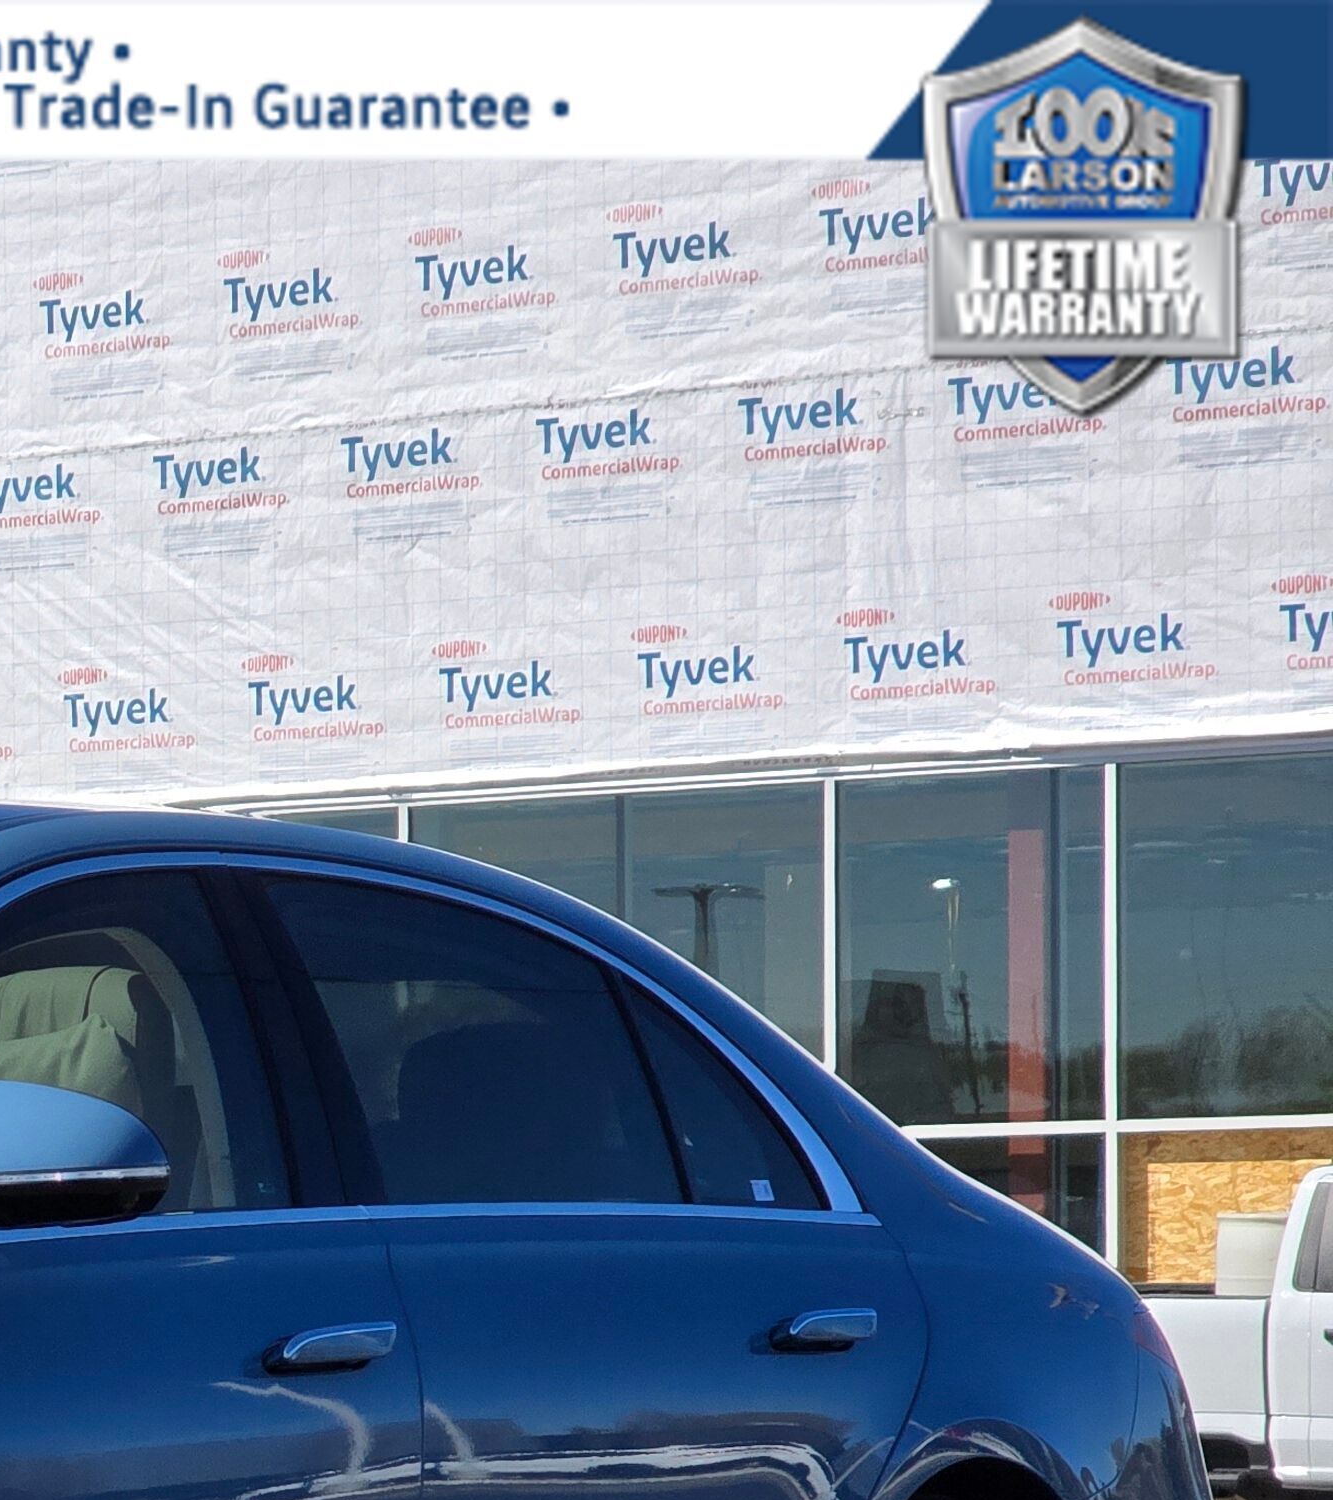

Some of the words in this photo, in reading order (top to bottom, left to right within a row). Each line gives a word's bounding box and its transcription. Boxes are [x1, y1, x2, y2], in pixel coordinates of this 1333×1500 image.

[416, 246, 528, 300] Tyvek
[615, 223, 731, 278] Tyvek
[43, 293, 145, 342] Tyvek
[225, 271, 332, 320] Tyvek
[45, 334, 171, 359] CommercialWrap
[230, 313, 359, 340] CommercialWrap
[537, 410, 651, 463] Tyvek
[740, 389, 856, 443] Tyvek
[955, 417, 1104, 443] CommercialWrap
[155, 449, 260, 497] Tyvek
[343, 429, 451, 481] Tyvek
[543, 457, 681, 480] CommercialWrap
[744, 437, 887, 462] CommercialWrap
[160, 493, 286, 516] CommercialWrap
[348, 475, 480, 498] CommercialWrap
[845, 632, 964, 683] Tyvek
[1058, 614, 1184, 667] Tyvek
[440, 661, 551, 712] Tyvek
[639, 647, 753, 698] Tyvek
[1065, 663, 1217, 687] CommercialWrap
[66, 690, 167, 735] Tyvek
[250, 677, 356, 725] Tyvek
